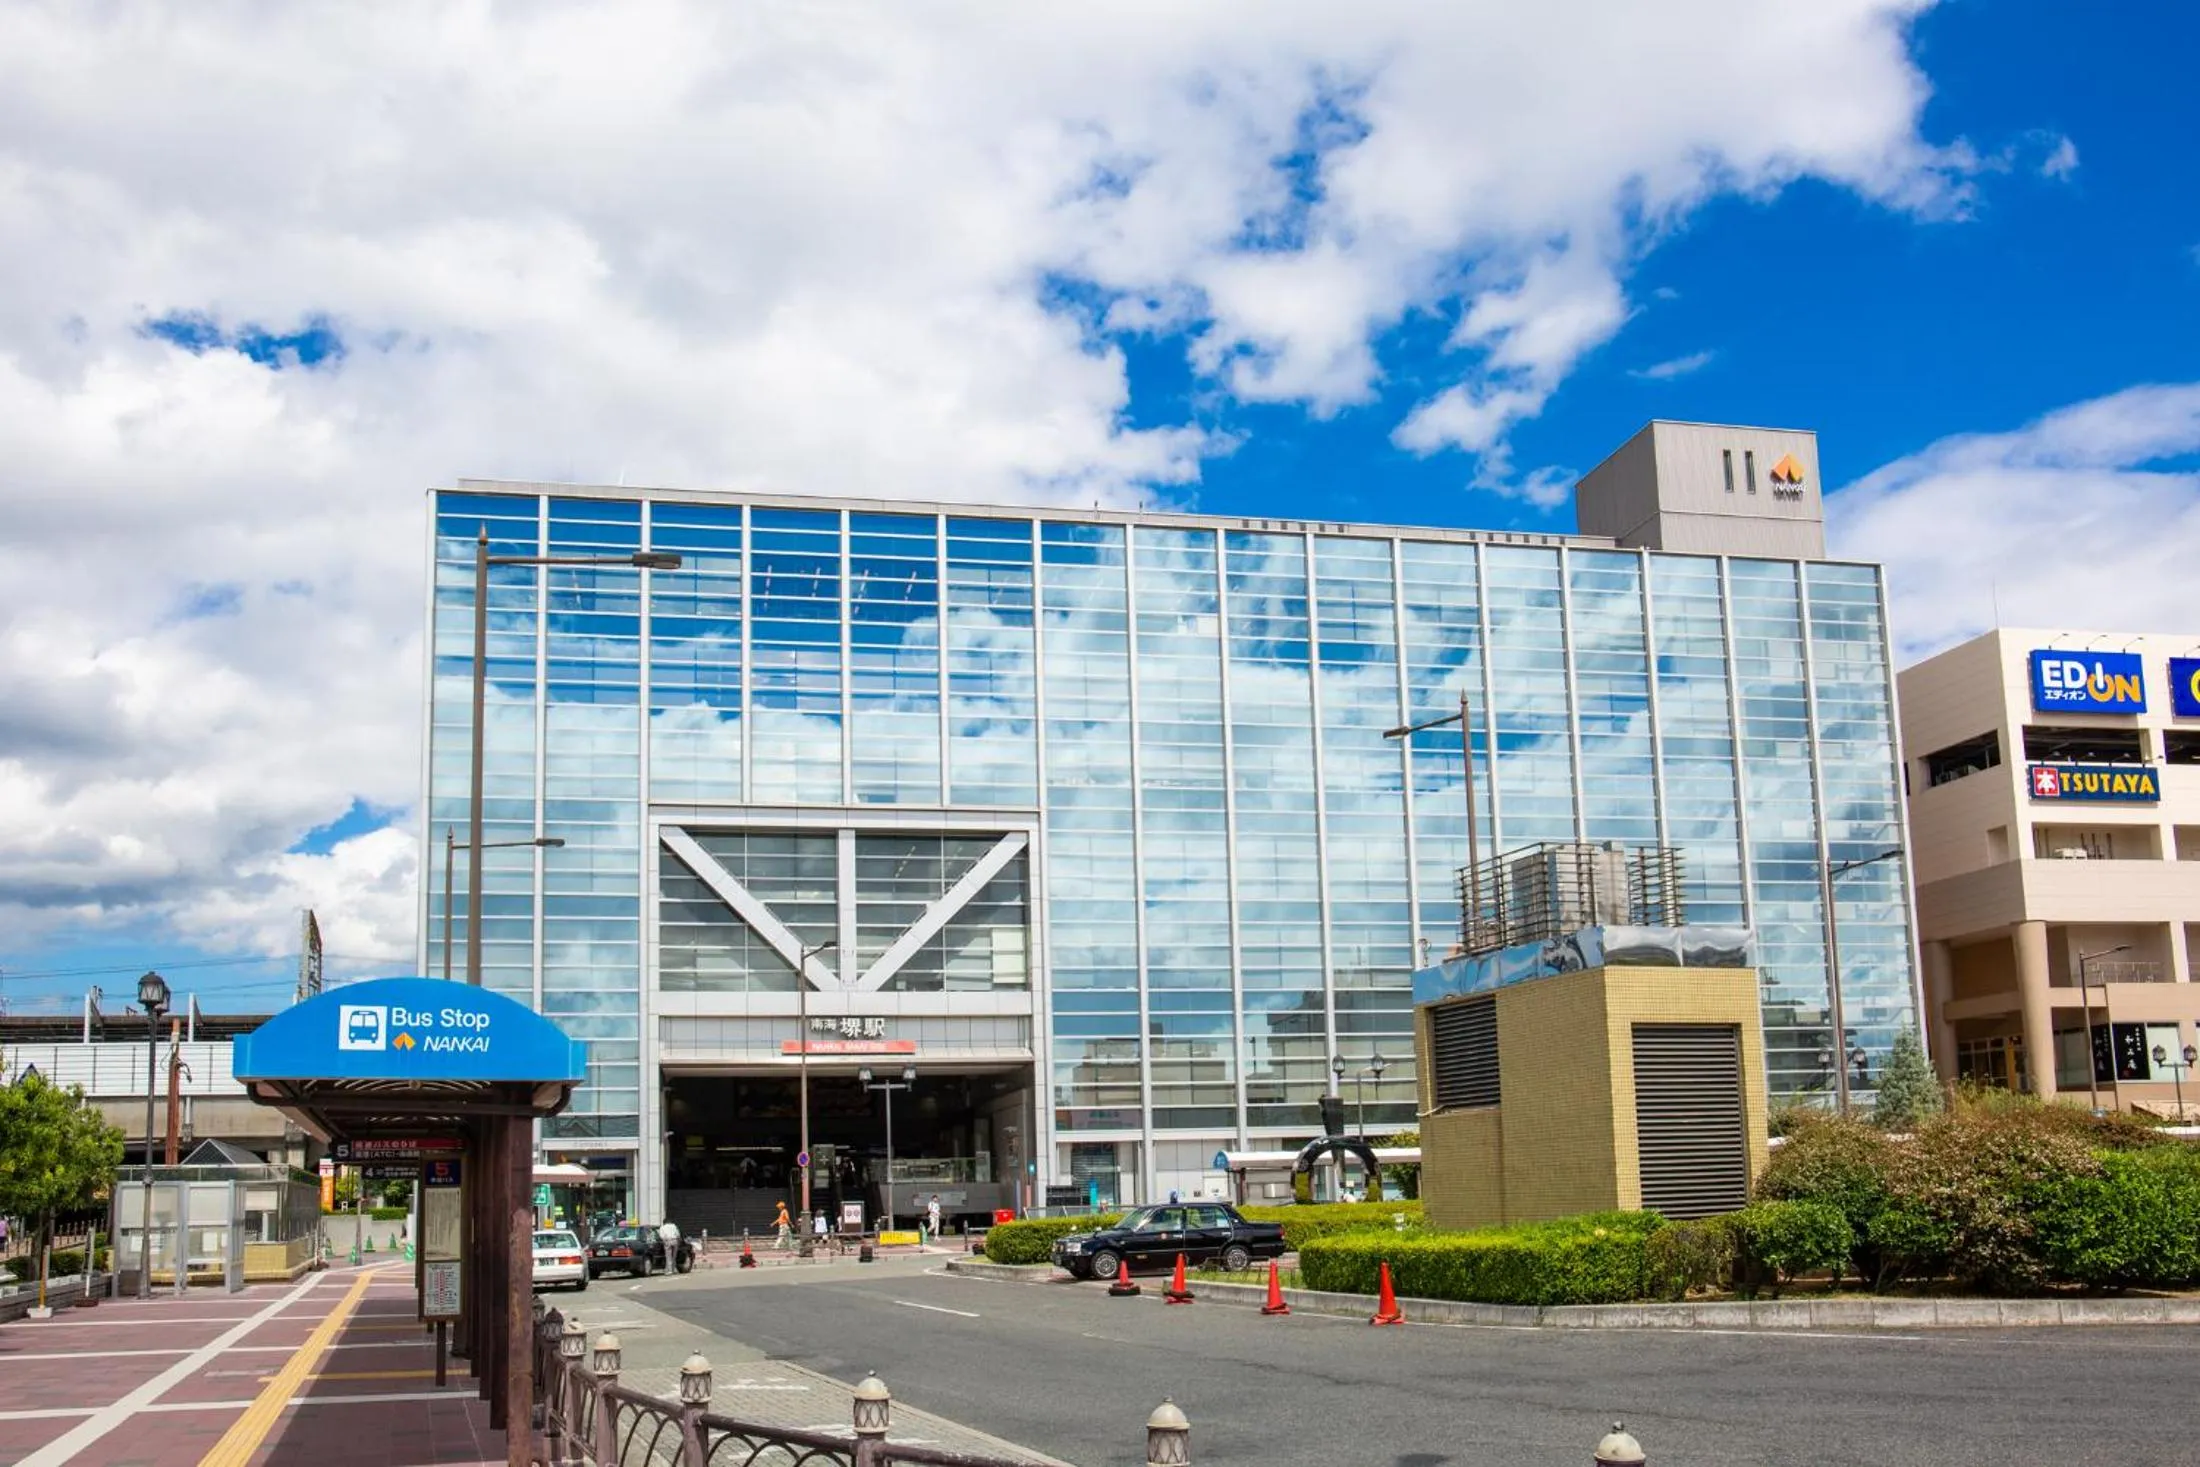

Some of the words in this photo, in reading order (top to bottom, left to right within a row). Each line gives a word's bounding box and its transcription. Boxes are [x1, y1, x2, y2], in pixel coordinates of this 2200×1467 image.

[2040, 659, 2142, 703] EDION
[2044, 689, 2087, 701] エディオン
[2036, 770, 2056, 795] 本
[2059, 771, 2156, 795] TSUTAYA
[391, 1007, 433, 1027] Bus
[440, 1008, 490, 1032] Stop
[840, 1017, 885, 1038] 堺駅
[422, 1035, 490, 1053] NANKAI
[336, 1144, 349, 1157] 5
[364, 1167, 374, 1177] 4
